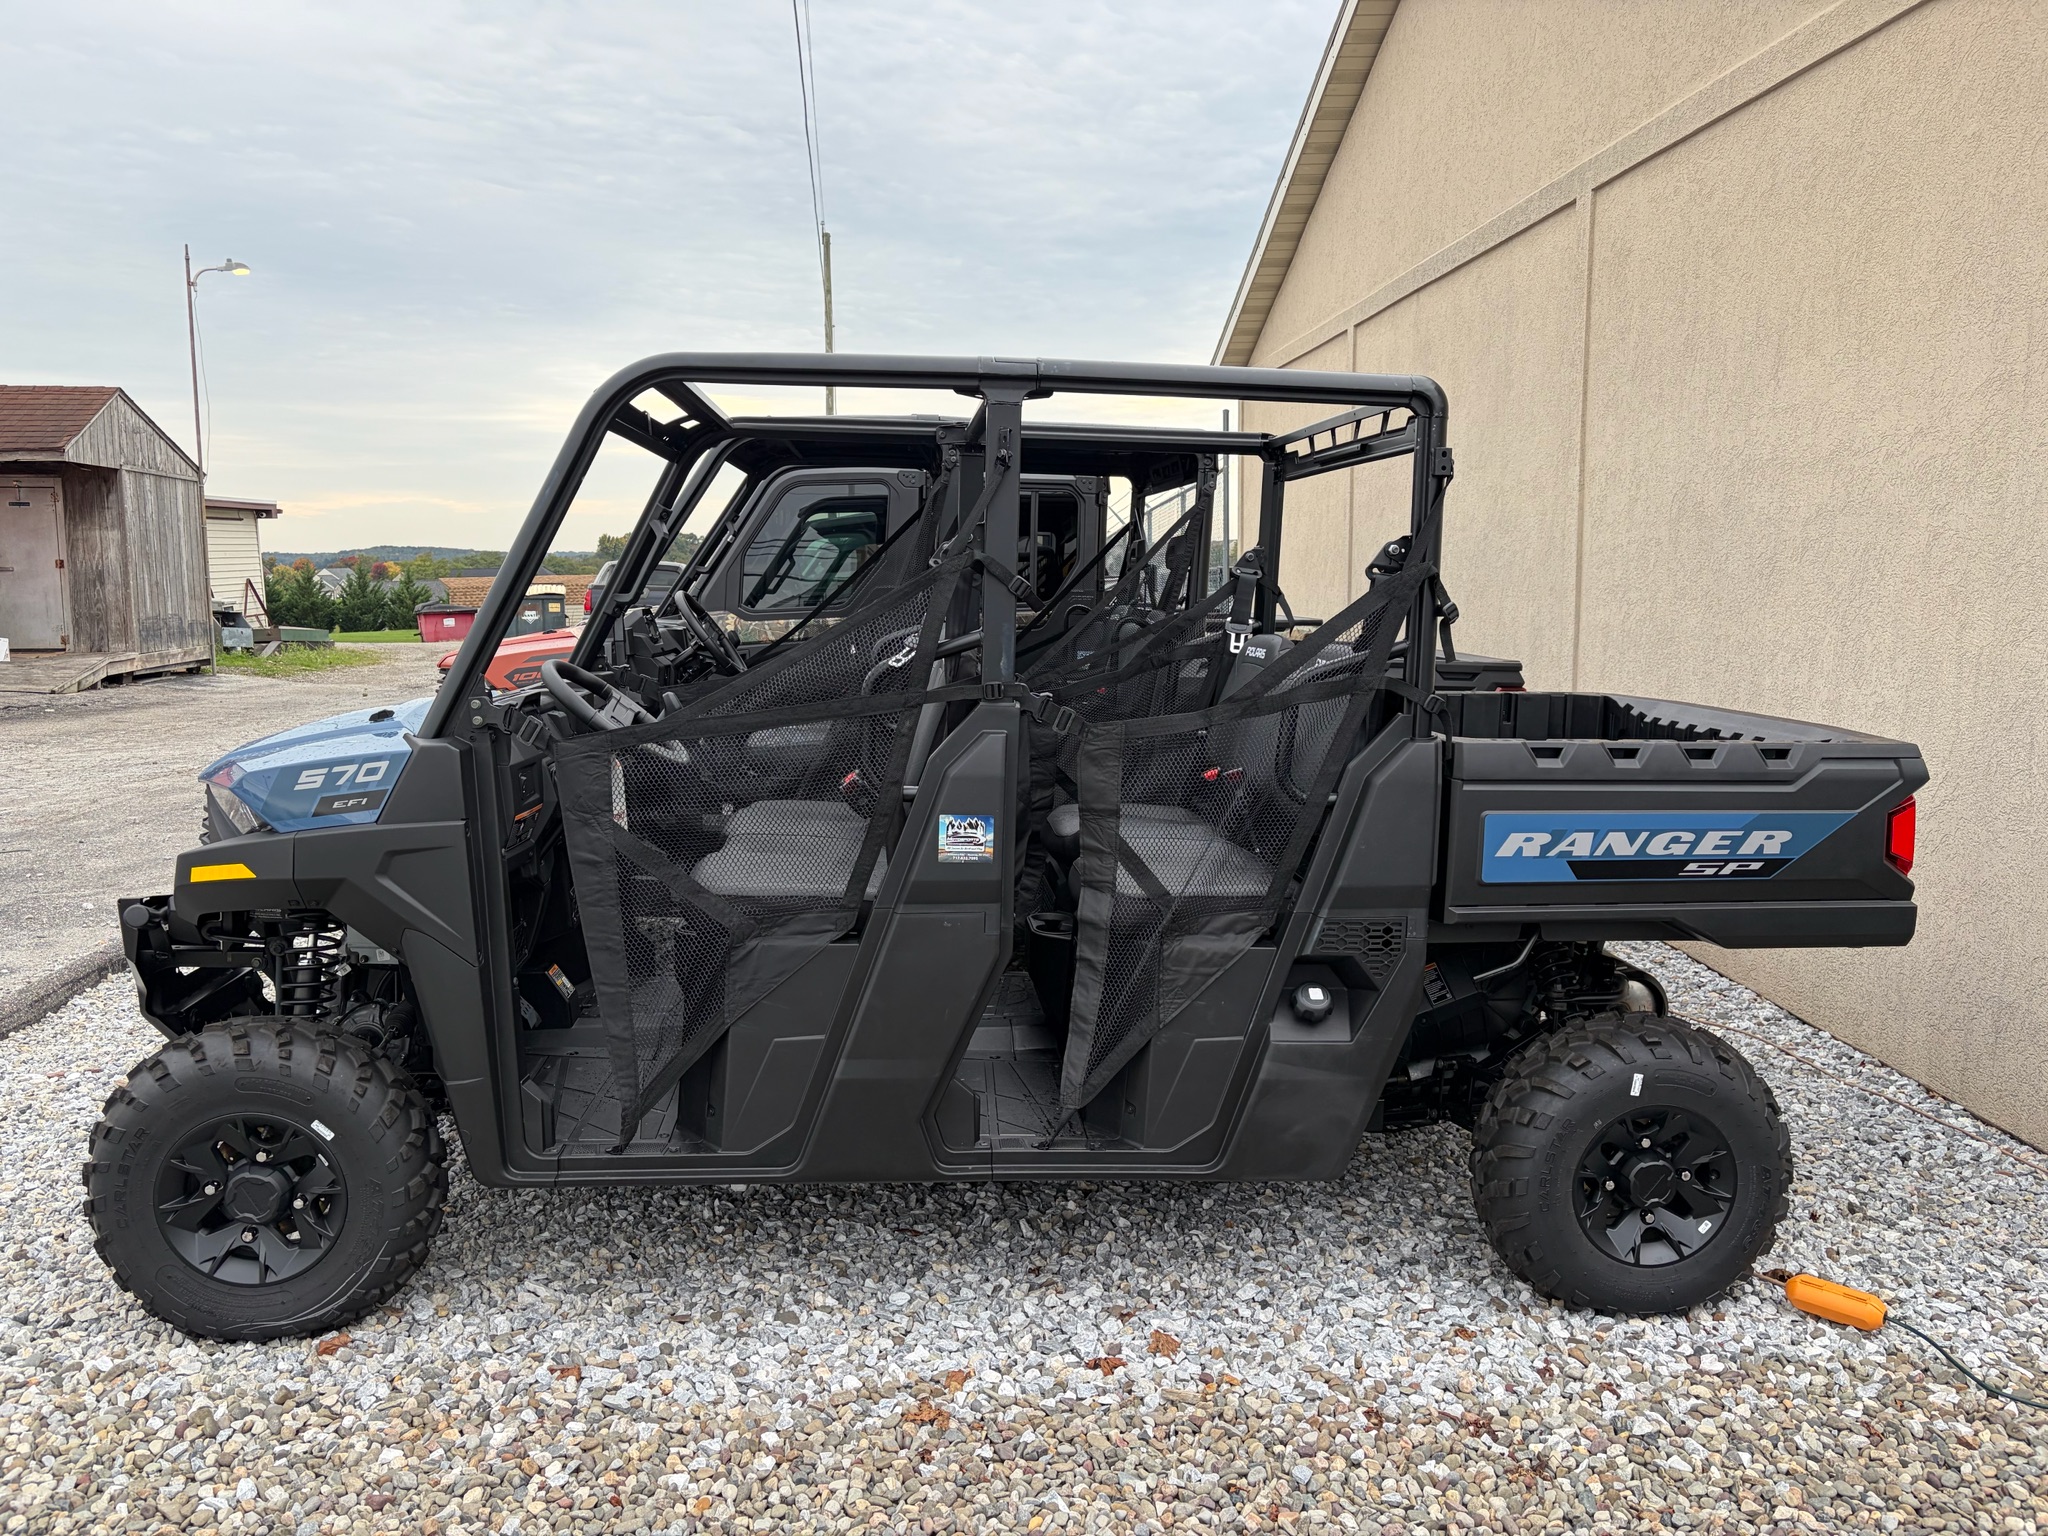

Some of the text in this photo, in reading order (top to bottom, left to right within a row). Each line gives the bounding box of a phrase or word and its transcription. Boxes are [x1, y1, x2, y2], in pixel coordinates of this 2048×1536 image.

[1245, 646, 1267, 659] POLARIS
[293, 760, 390, 791] 570
[332, 797, 368, 809] EFI
[1494, 830, 1793, 858] RANGER
[1678, 861, 1765, 876] SP
[113, 1126, 152, 1229] CARLSTAR
[1539, 1118, 1577, 1213] CARLSTAR
